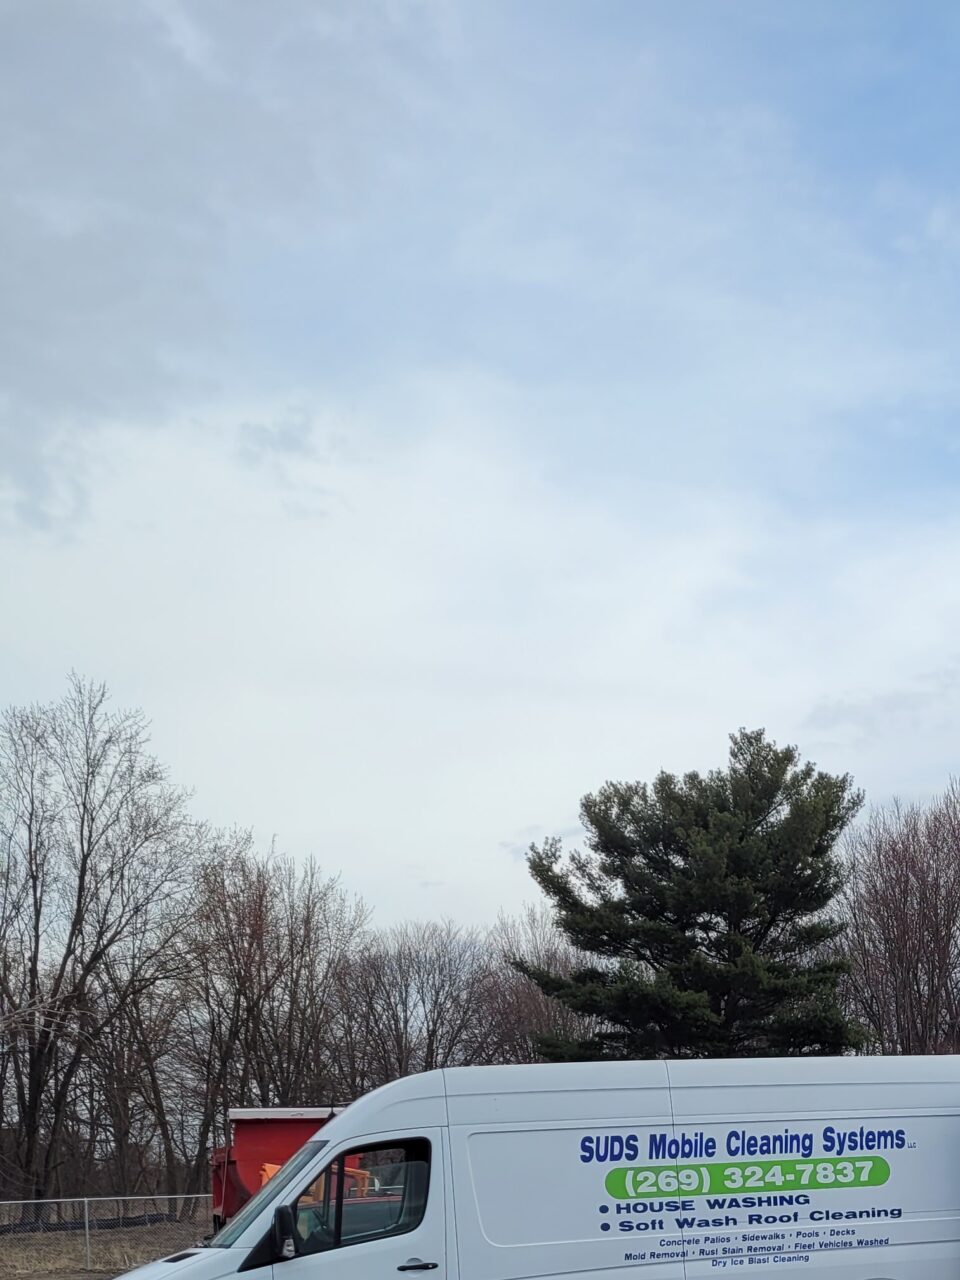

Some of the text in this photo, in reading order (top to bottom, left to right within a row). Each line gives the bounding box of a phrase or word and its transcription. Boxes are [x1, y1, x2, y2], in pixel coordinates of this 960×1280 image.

[580, 1134, 639, 1163] SUDS
[648, 1132, 717, 1160] Mobile
[726, 1129, 814, 1158] Cleaning
[822, 1126, 906, 1156] Systems
[625, 1161, 874, 1197] (269) 324-7837
[616, 1194, 810, 1214] HOUSE WASHING
[619, 1208, 902, 1232] Soft Wash Roof Cleaning
[624, 1237, 890, 1261] Mold Removal Rust Stain Removal Fleet Vehicles Washed
[659, 1228, 856, 1247] Concrete Patios Sidewalks Pools Decks
[711, 1254, 810, 1267] Dry Ice Blast Cleaning
